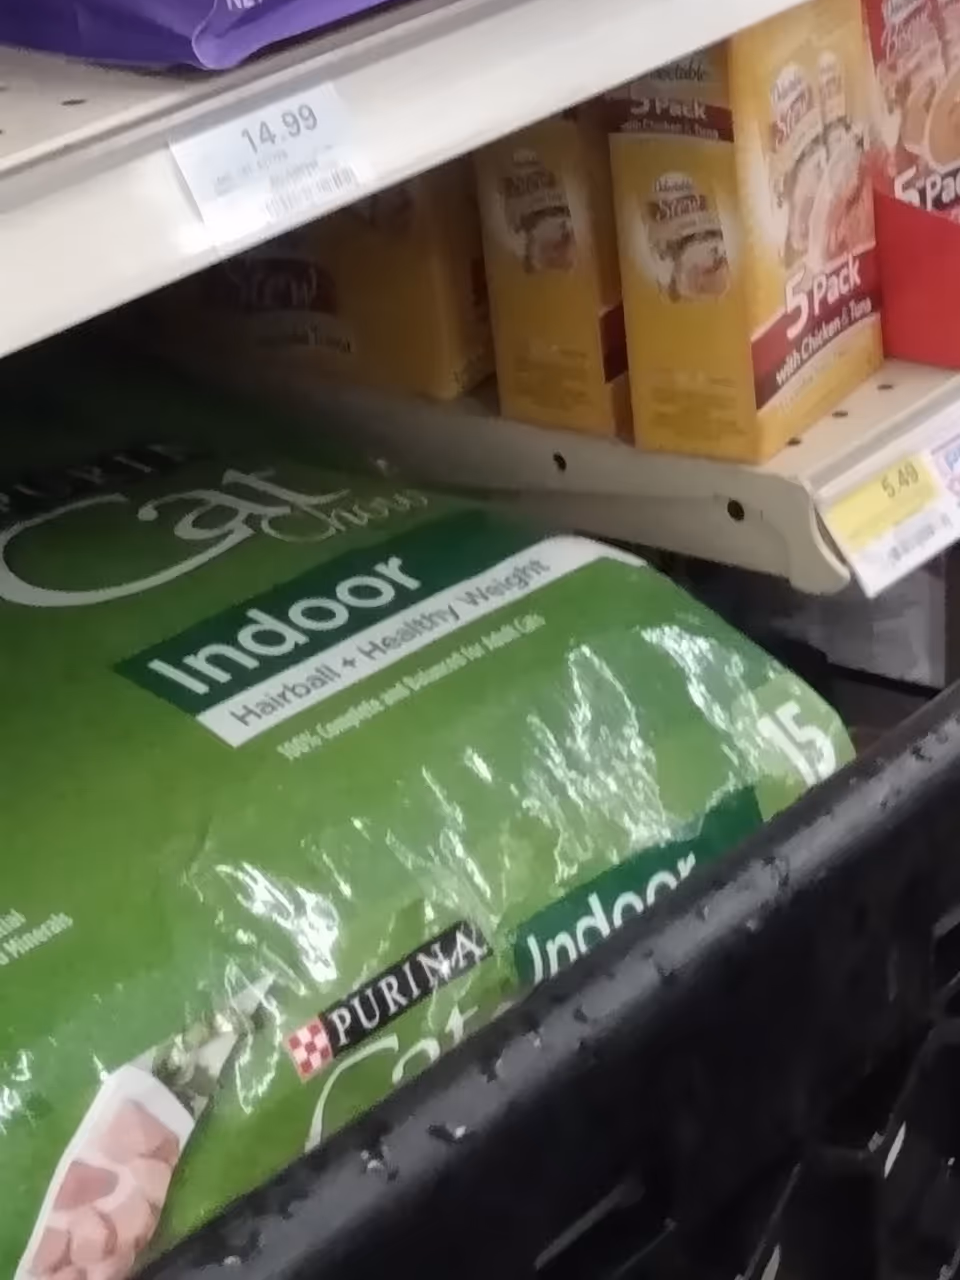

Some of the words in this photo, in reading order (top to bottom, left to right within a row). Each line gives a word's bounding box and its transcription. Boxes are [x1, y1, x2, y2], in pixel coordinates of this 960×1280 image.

[241, 104, 318, 154] 14.99
[775, 347, 800, 386] with
[801, 317, 841, 359] Chicken
[850, 296, 873, 322] Tuna
[784, 267, 809, 339] 5
[813, 252, 861, 317] Pack
[0, 469, 351, 607] Cat
[147, 556, 422, 696] Indoor
[229, 664, 342, 727] Hairball
[341, 656, 356, 672] +
[357, 603, 461, 662] Healthy
[454, 556, 551, 608] Weight
[276, 733, 322, 761] 100%
[315, 700, 386, 740] Complete
[382, 681, 410, 699] and
[403, 652, 469, 691] Balanced
[757, 700, 837, 789] 15
[3, 912, 74, 960] Minerals
[329, 926, 489, 1046] PURINA
